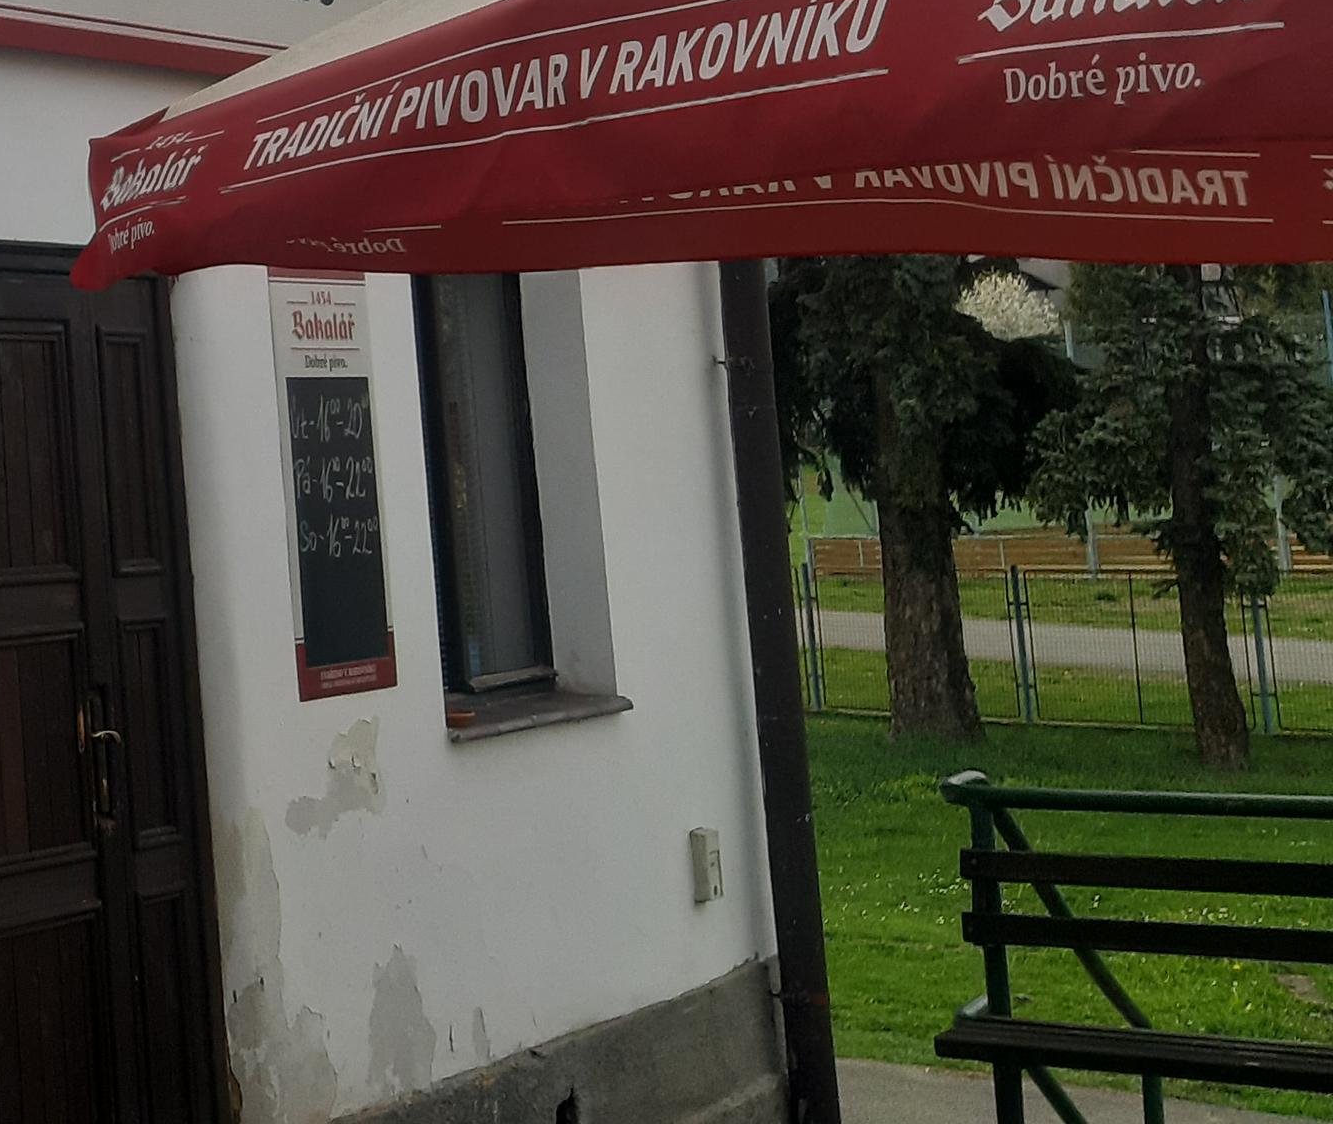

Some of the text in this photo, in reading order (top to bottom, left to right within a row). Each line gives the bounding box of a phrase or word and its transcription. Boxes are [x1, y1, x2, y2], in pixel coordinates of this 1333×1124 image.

[1002, 52, 1203, 107] Dobré pivo.
[243, 79, 402, 172] TRADIČNÍ
[391, 52, 572, 137] PIVOVAR
[579, 44, 613, 98] V
[130, 217, 156, 250] pivo.
[309, 289, 332, 306] 1454
[290, 309, 357, 343] Bakalář
[304, 354, 328, 369] Dobré
